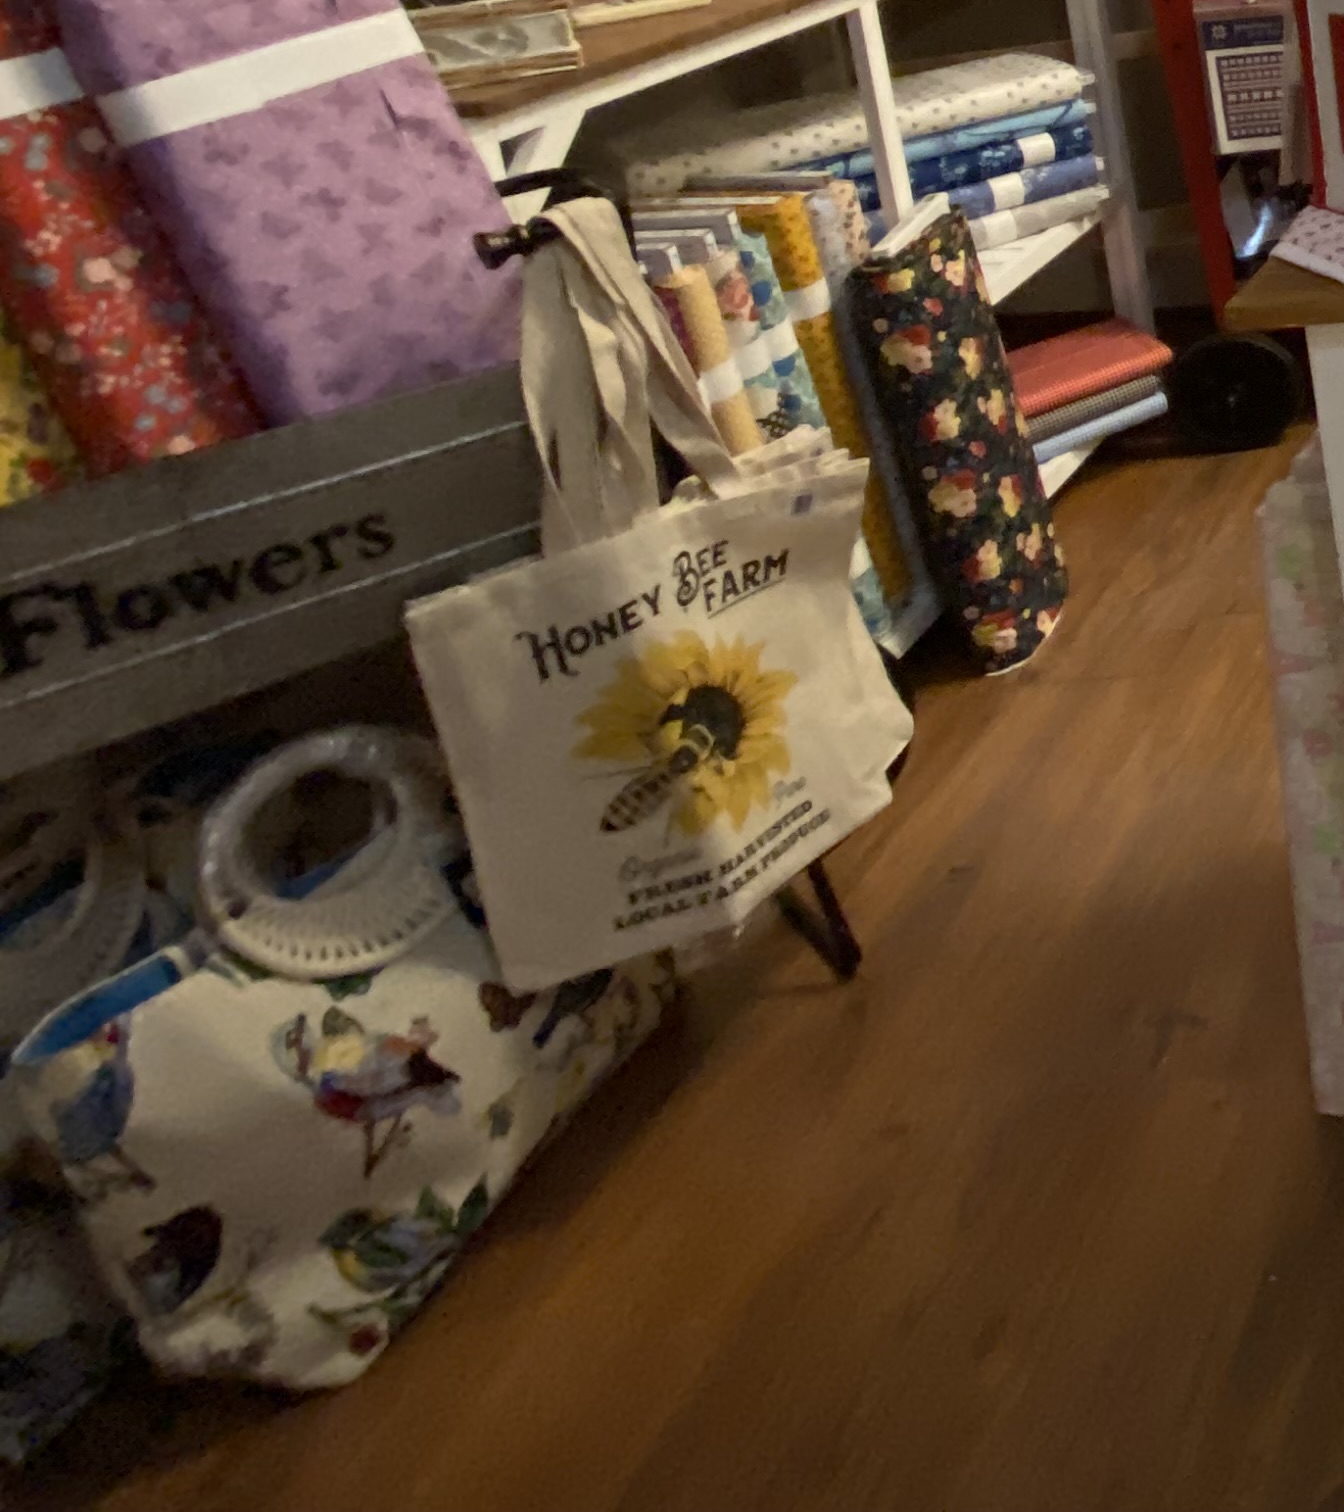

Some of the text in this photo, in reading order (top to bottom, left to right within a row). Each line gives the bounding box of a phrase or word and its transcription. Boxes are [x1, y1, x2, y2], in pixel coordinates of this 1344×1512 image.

[0, 512, 395, 677] Flowers
[514, 540, 729, 684] HONEY BEE
[702, 548, 790, 613] FARM
[628, 799, 813, 905] FRESH HARVESTED
[614, 899, 692, 933] LOCAL
